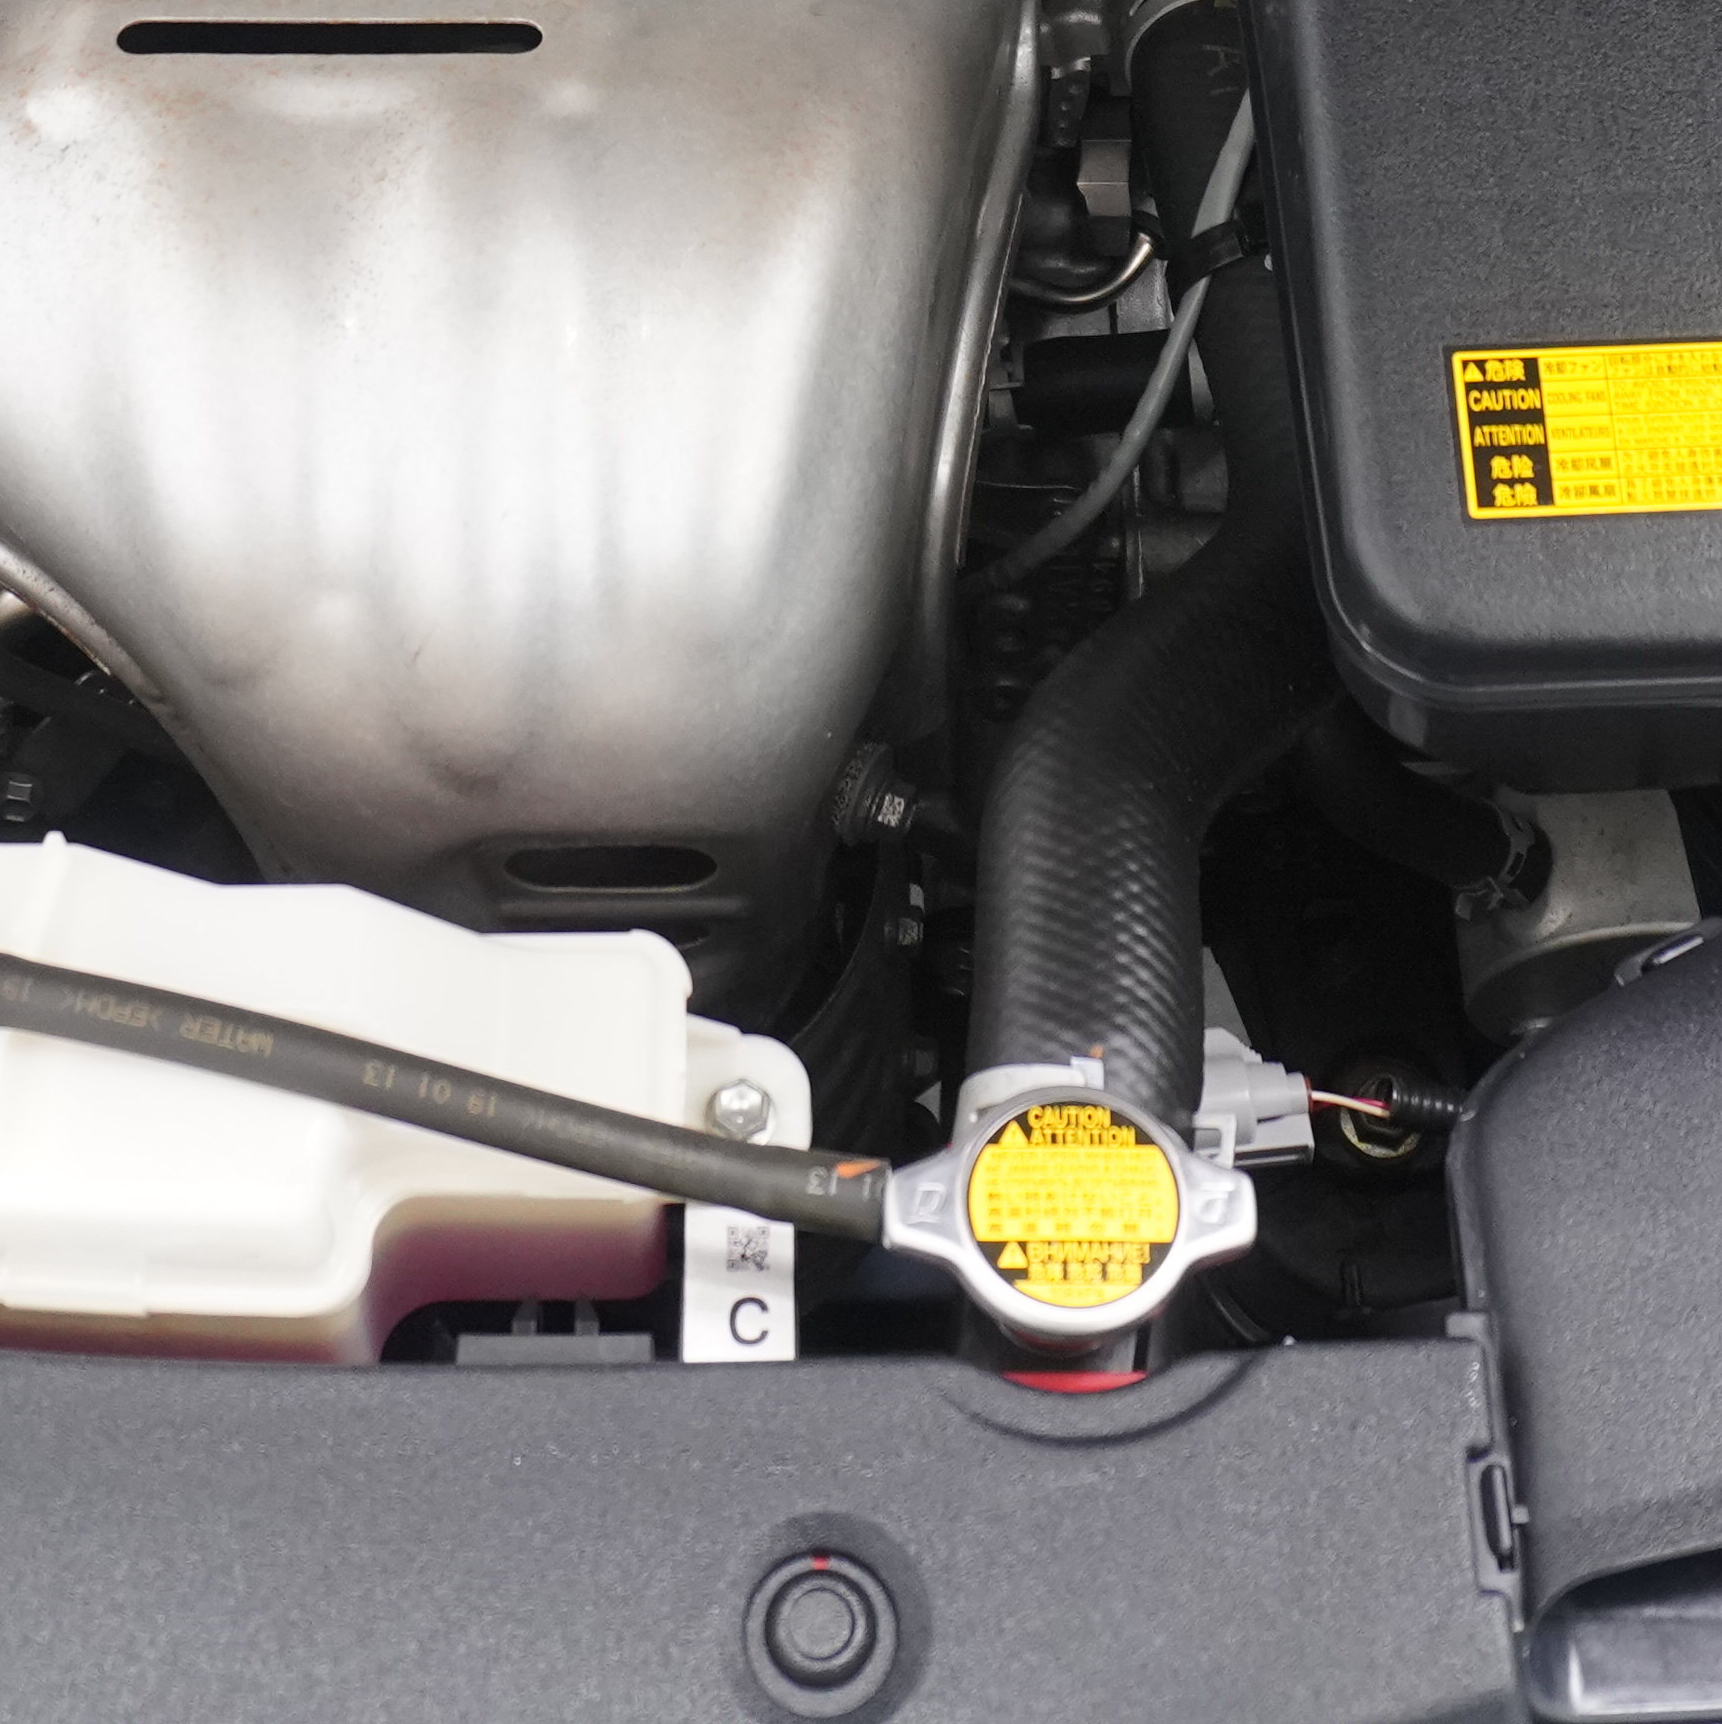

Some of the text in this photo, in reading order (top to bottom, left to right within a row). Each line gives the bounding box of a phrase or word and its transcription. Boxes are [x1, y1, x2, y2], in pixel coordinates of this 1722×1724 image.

[1468, 388, 1541, 412] CAUTION
[1473, 423, 1545, 447] ATTENTION
[178, 1012, 276, 1060] WATER
[1027, 1107, 1111, 1128] CAUTION
[1029, 1126, 1136, 1146] ATTENTION
[727, 1296, 771, 1348] C
